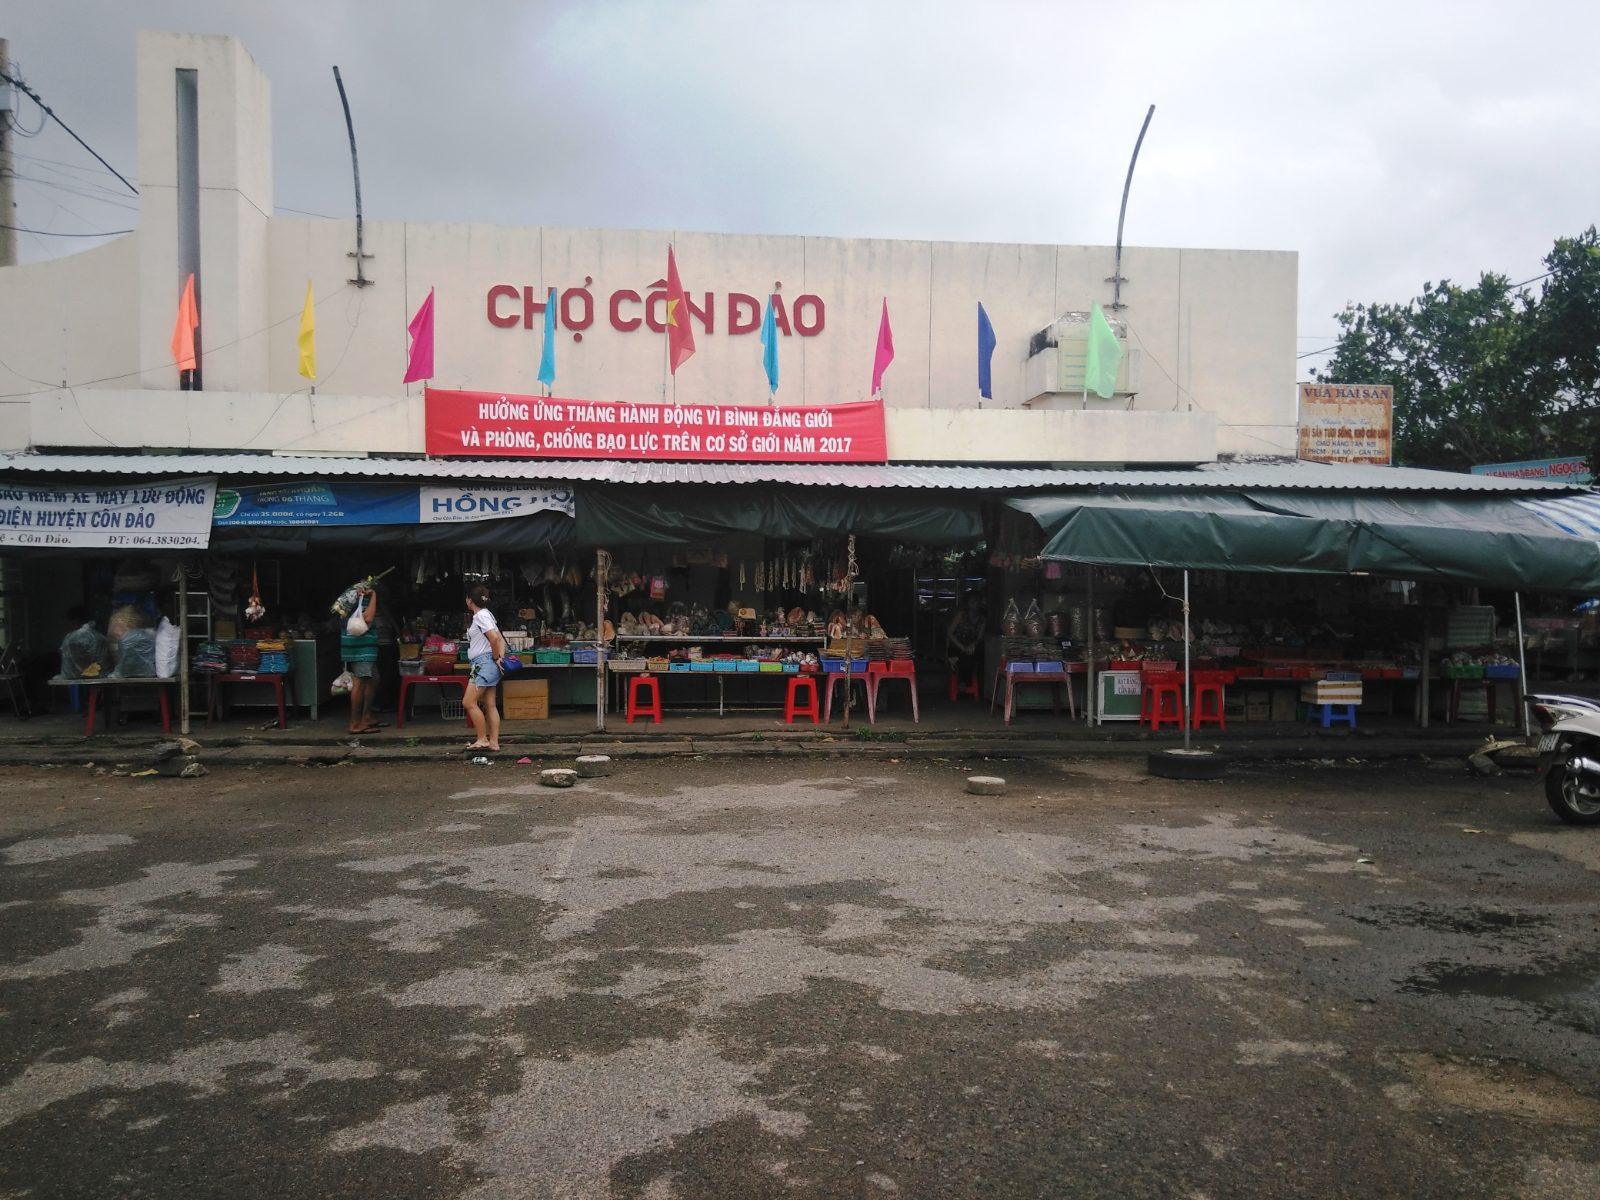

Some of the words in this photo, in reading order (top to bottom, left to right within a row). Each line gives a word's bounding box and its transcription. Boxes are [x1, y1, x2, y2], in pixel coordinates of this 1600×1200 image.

[479, 396, 529, 421] HƯỞNG
[533, 400, 563, 421] ỨNG
[567, 402, 615, 423] THÁNG
[620, 404, 659, 424] HÀNH
[663, 404, 703, 428] ĐỘNG
[706, 406, 720, 425] VÌ
[725, 408, 758, 427] BÌNH
[804, 408, 833, 428] GIỚI
[461, 426, 480, 447] VÀ
[485, 427, 540, 451] PHÒNG,
[543, 426, 592, 449] CHỐNG
[597, 434, 626, 453] BẠO
[631, 431, 659, 454] LỰC
[662, 431, 700, 451] TRÊN
[706, 434, 725, 452] CƠ
[729, 430, 748, 452] SỞ
[752, 432, 780, 452] GIỚI
[784, 434, 815, 453] NĂM
[819, 437, 852, 453] 2017
[165, 486, 205, 507] ĐỘNG
[36, 508, 87, 530] HUYỆN
[91, 508, 120, 528] CÔN
[124, 507, 156, 529] ĐẢO
[18, 533, 42, 543] Côn
[108, 535, 129, 544] ĐT:
